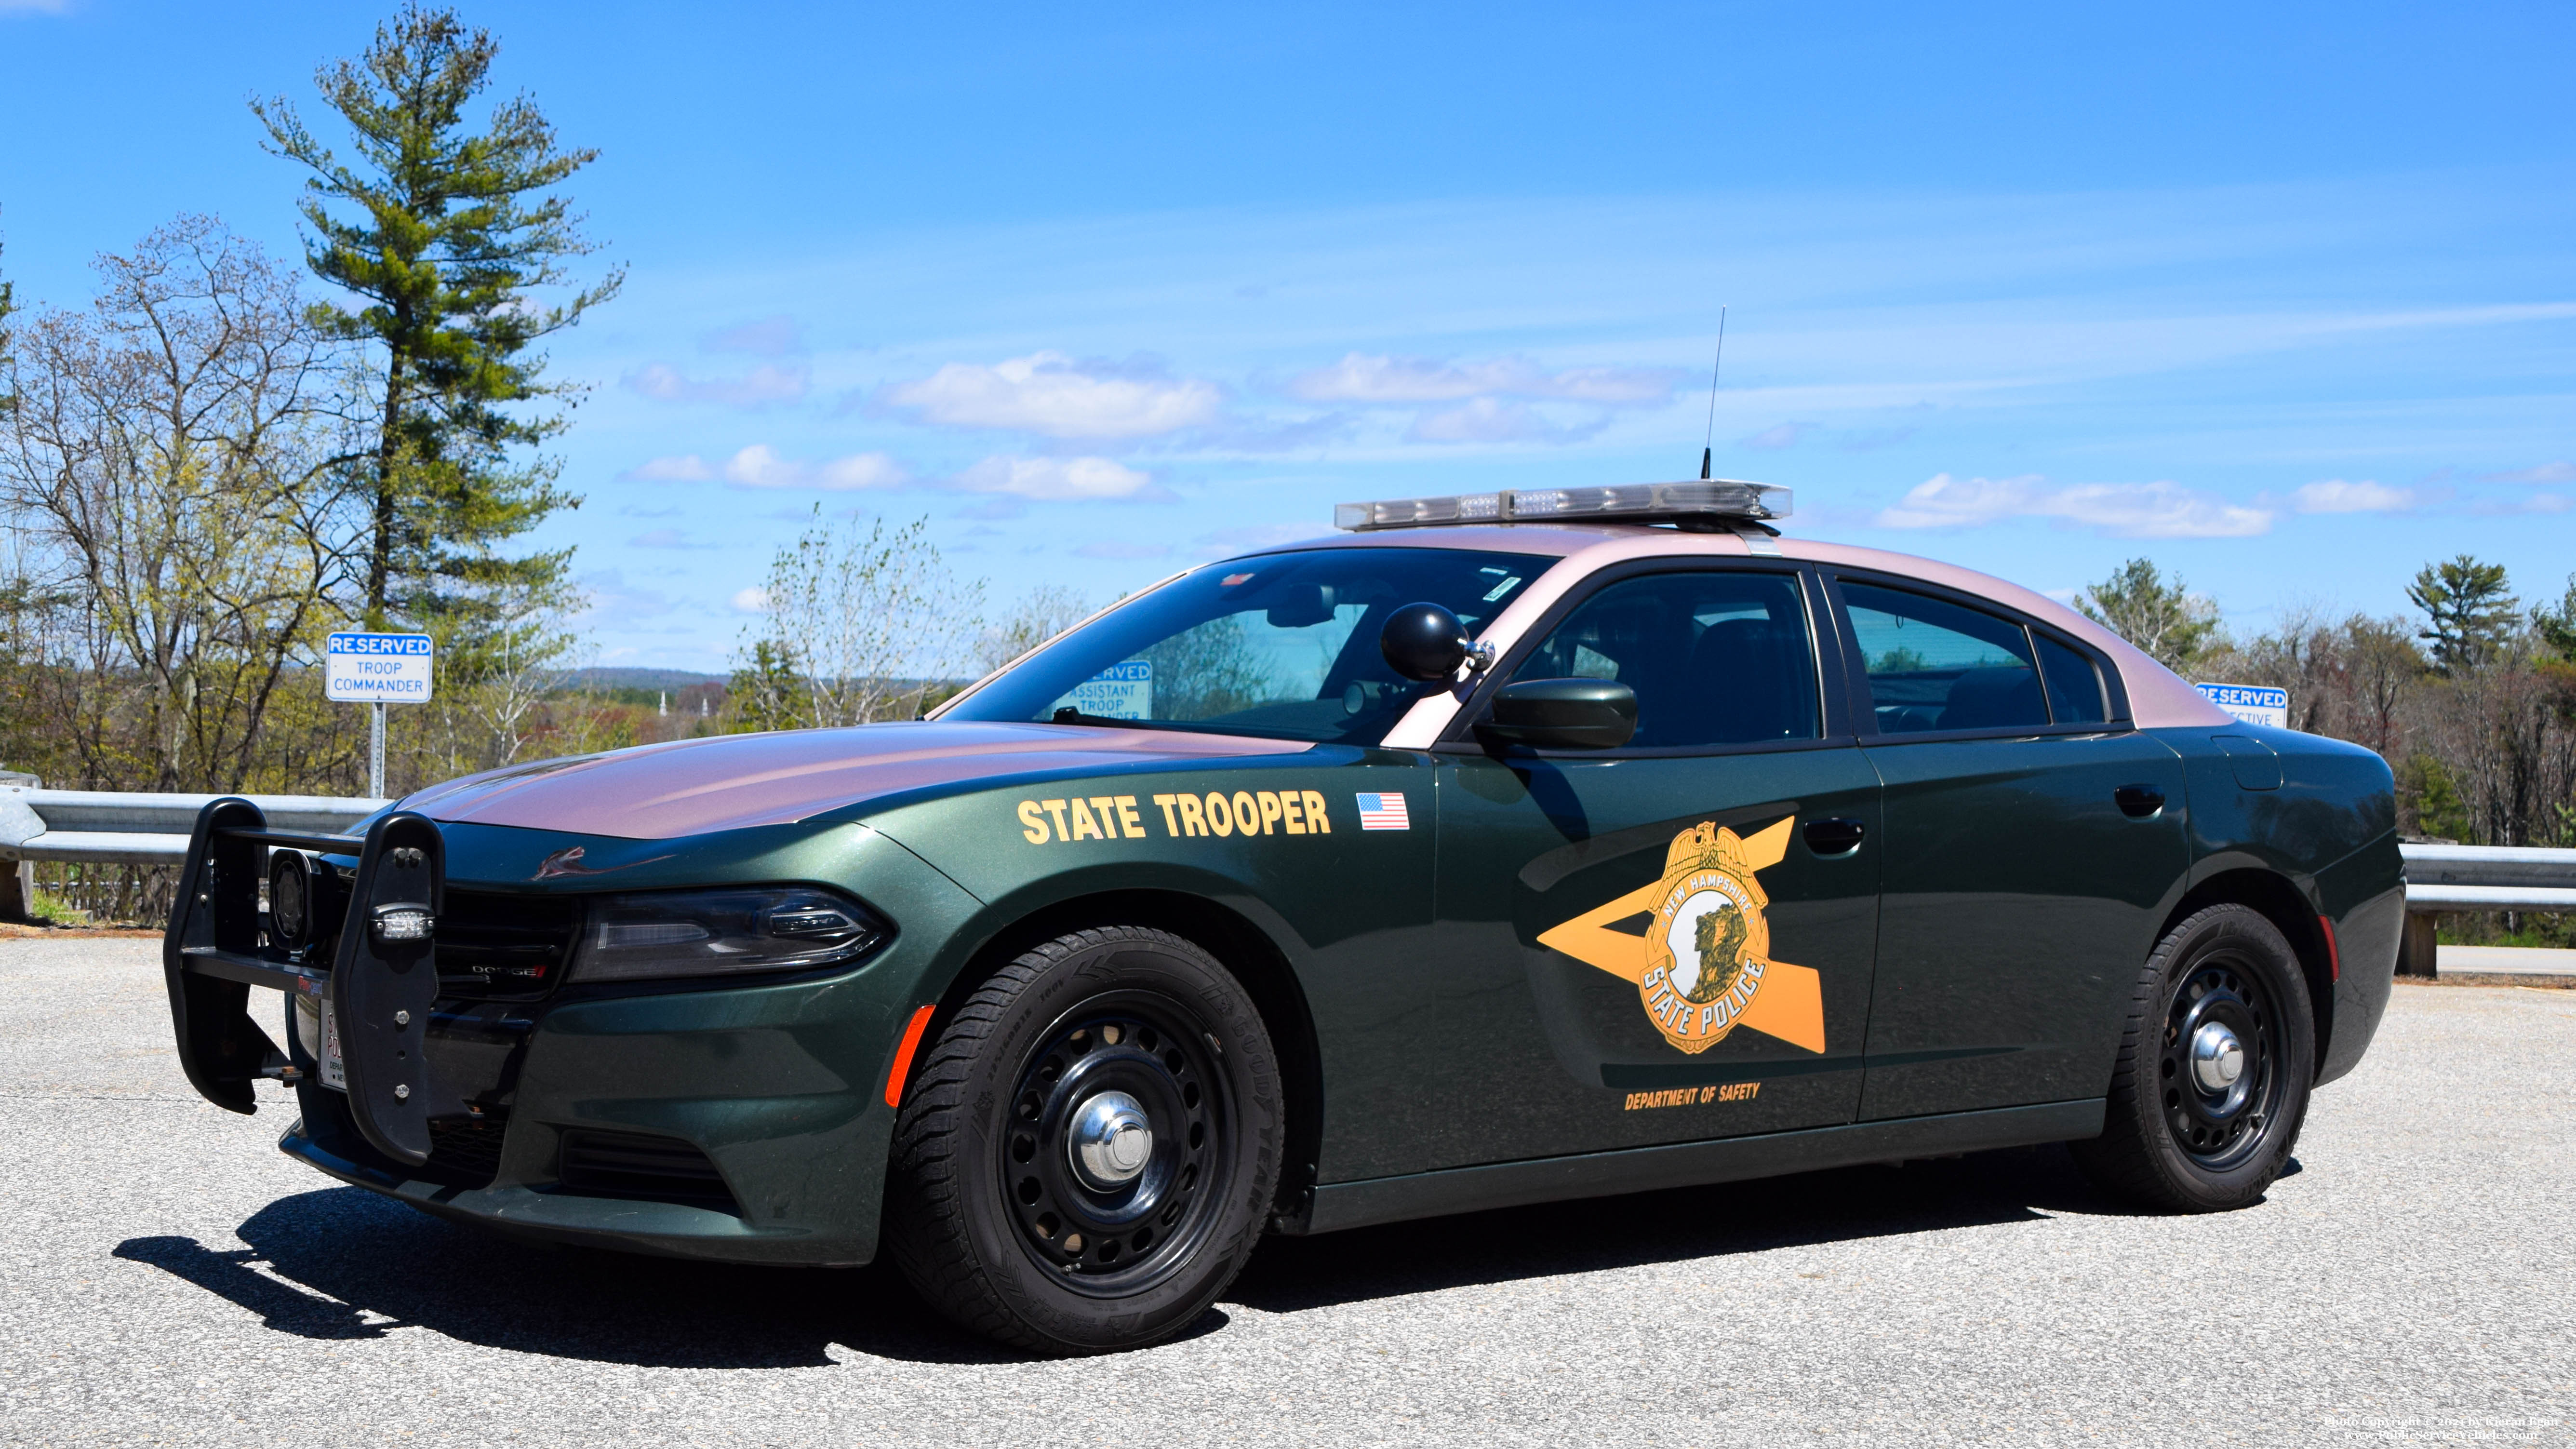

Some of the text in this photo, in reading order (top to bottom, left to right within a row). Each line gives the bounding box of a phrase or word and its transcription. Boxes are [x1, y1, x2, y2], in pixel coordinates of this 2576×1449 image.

[330, 637, 430, 654] RESERVED
[357, 662, 402, 674] TROOP
[334, 678, 422, 692] COMMANDER
[1069, 684, 1135, 698] ASSISTANT
[1080, 699, 1124, 711] TROOP
[1017, 791, 1331, 845] STATE TROOPER
[1664, 874, 1751, 917] NEW HAMPSHIRE
[1644, 958, 1766, 1035] STATE POLICE
[330, 1060, 343, 1072] DEPAR
[1625, 1083, 1761, 1111] DEPARTMENT OF SAFETY
